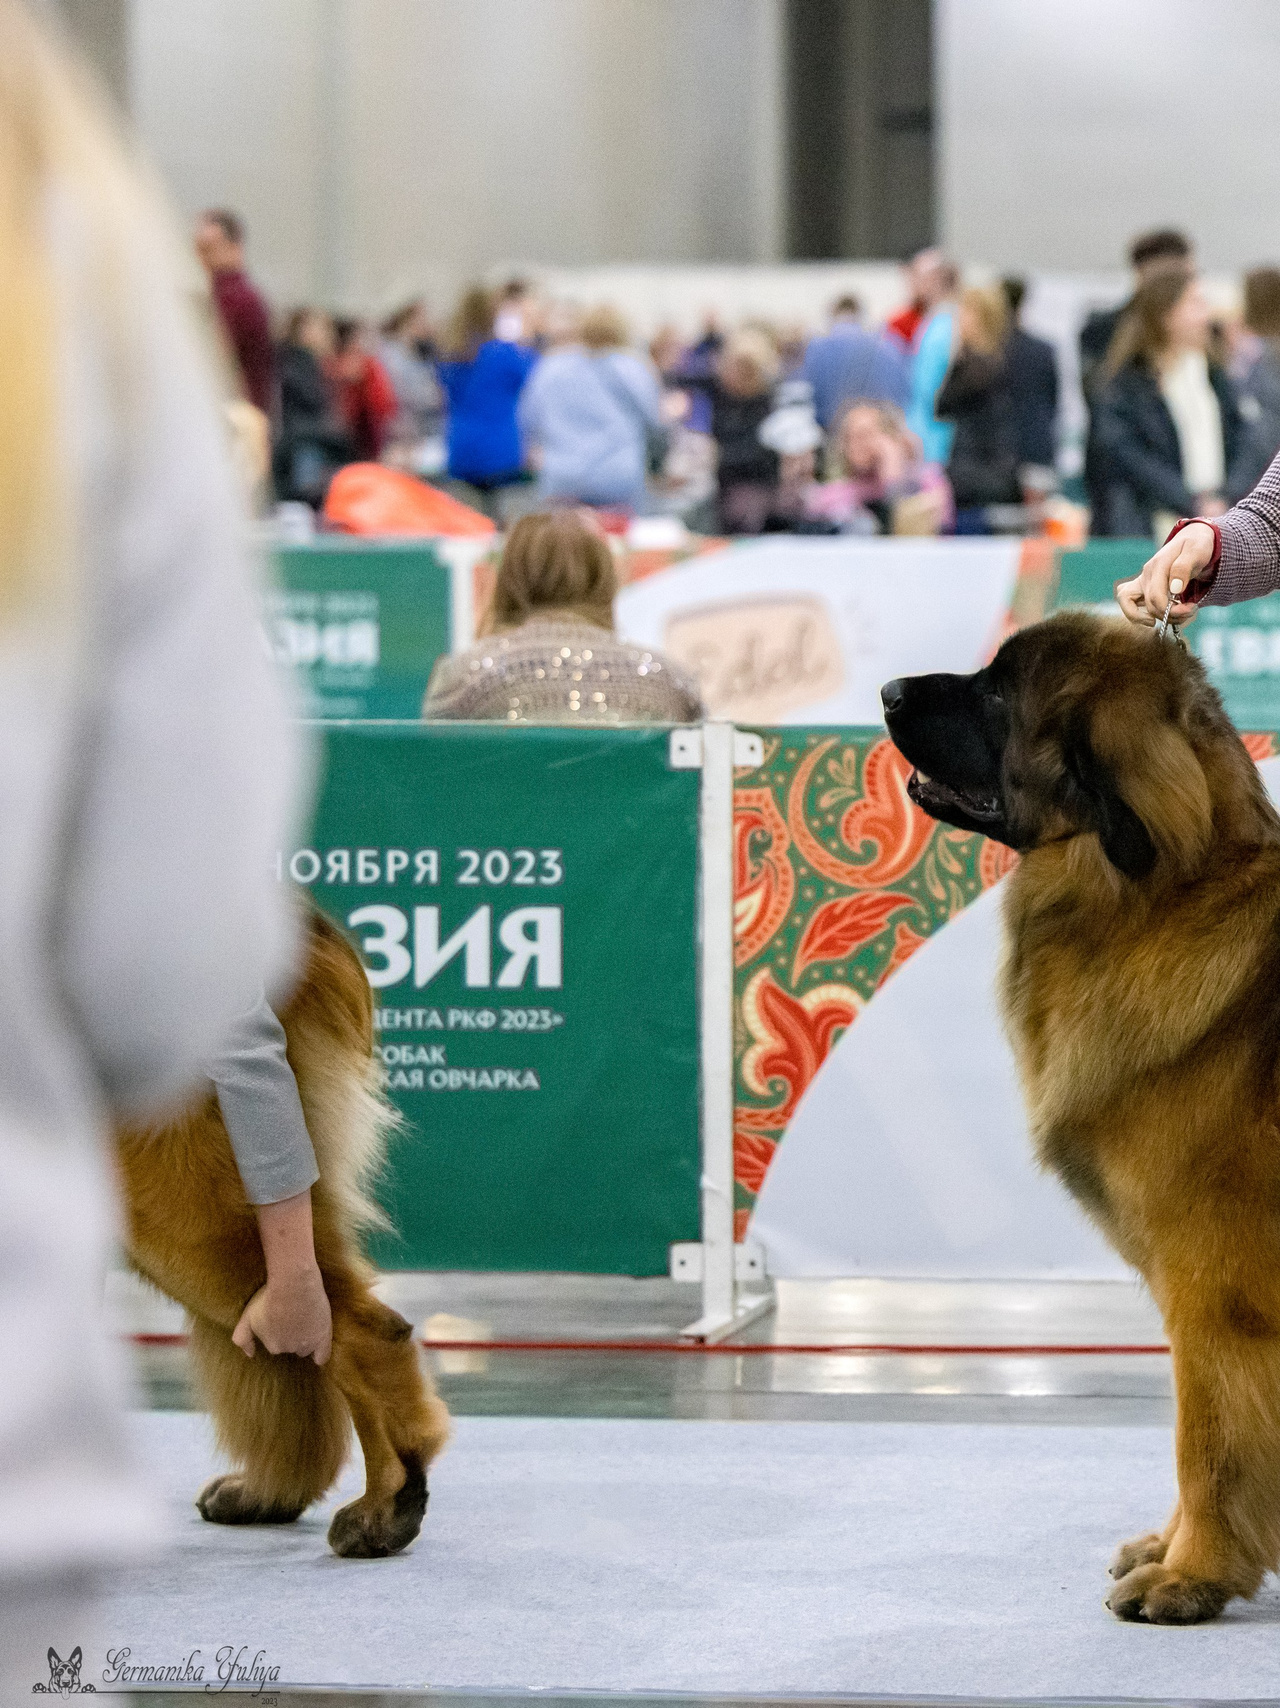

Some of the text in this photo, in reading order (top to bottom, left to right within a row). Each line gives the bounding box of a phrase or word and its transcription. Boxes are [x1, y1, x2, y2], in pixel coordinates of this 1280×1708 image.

[456, 848, 563, 885] 2023
[346, 903, 563, 990] ЗИЯ
[447, 1007, 497, 1030] РКФ
[427, 1067, 541, 1090] ОВЧАРКА
